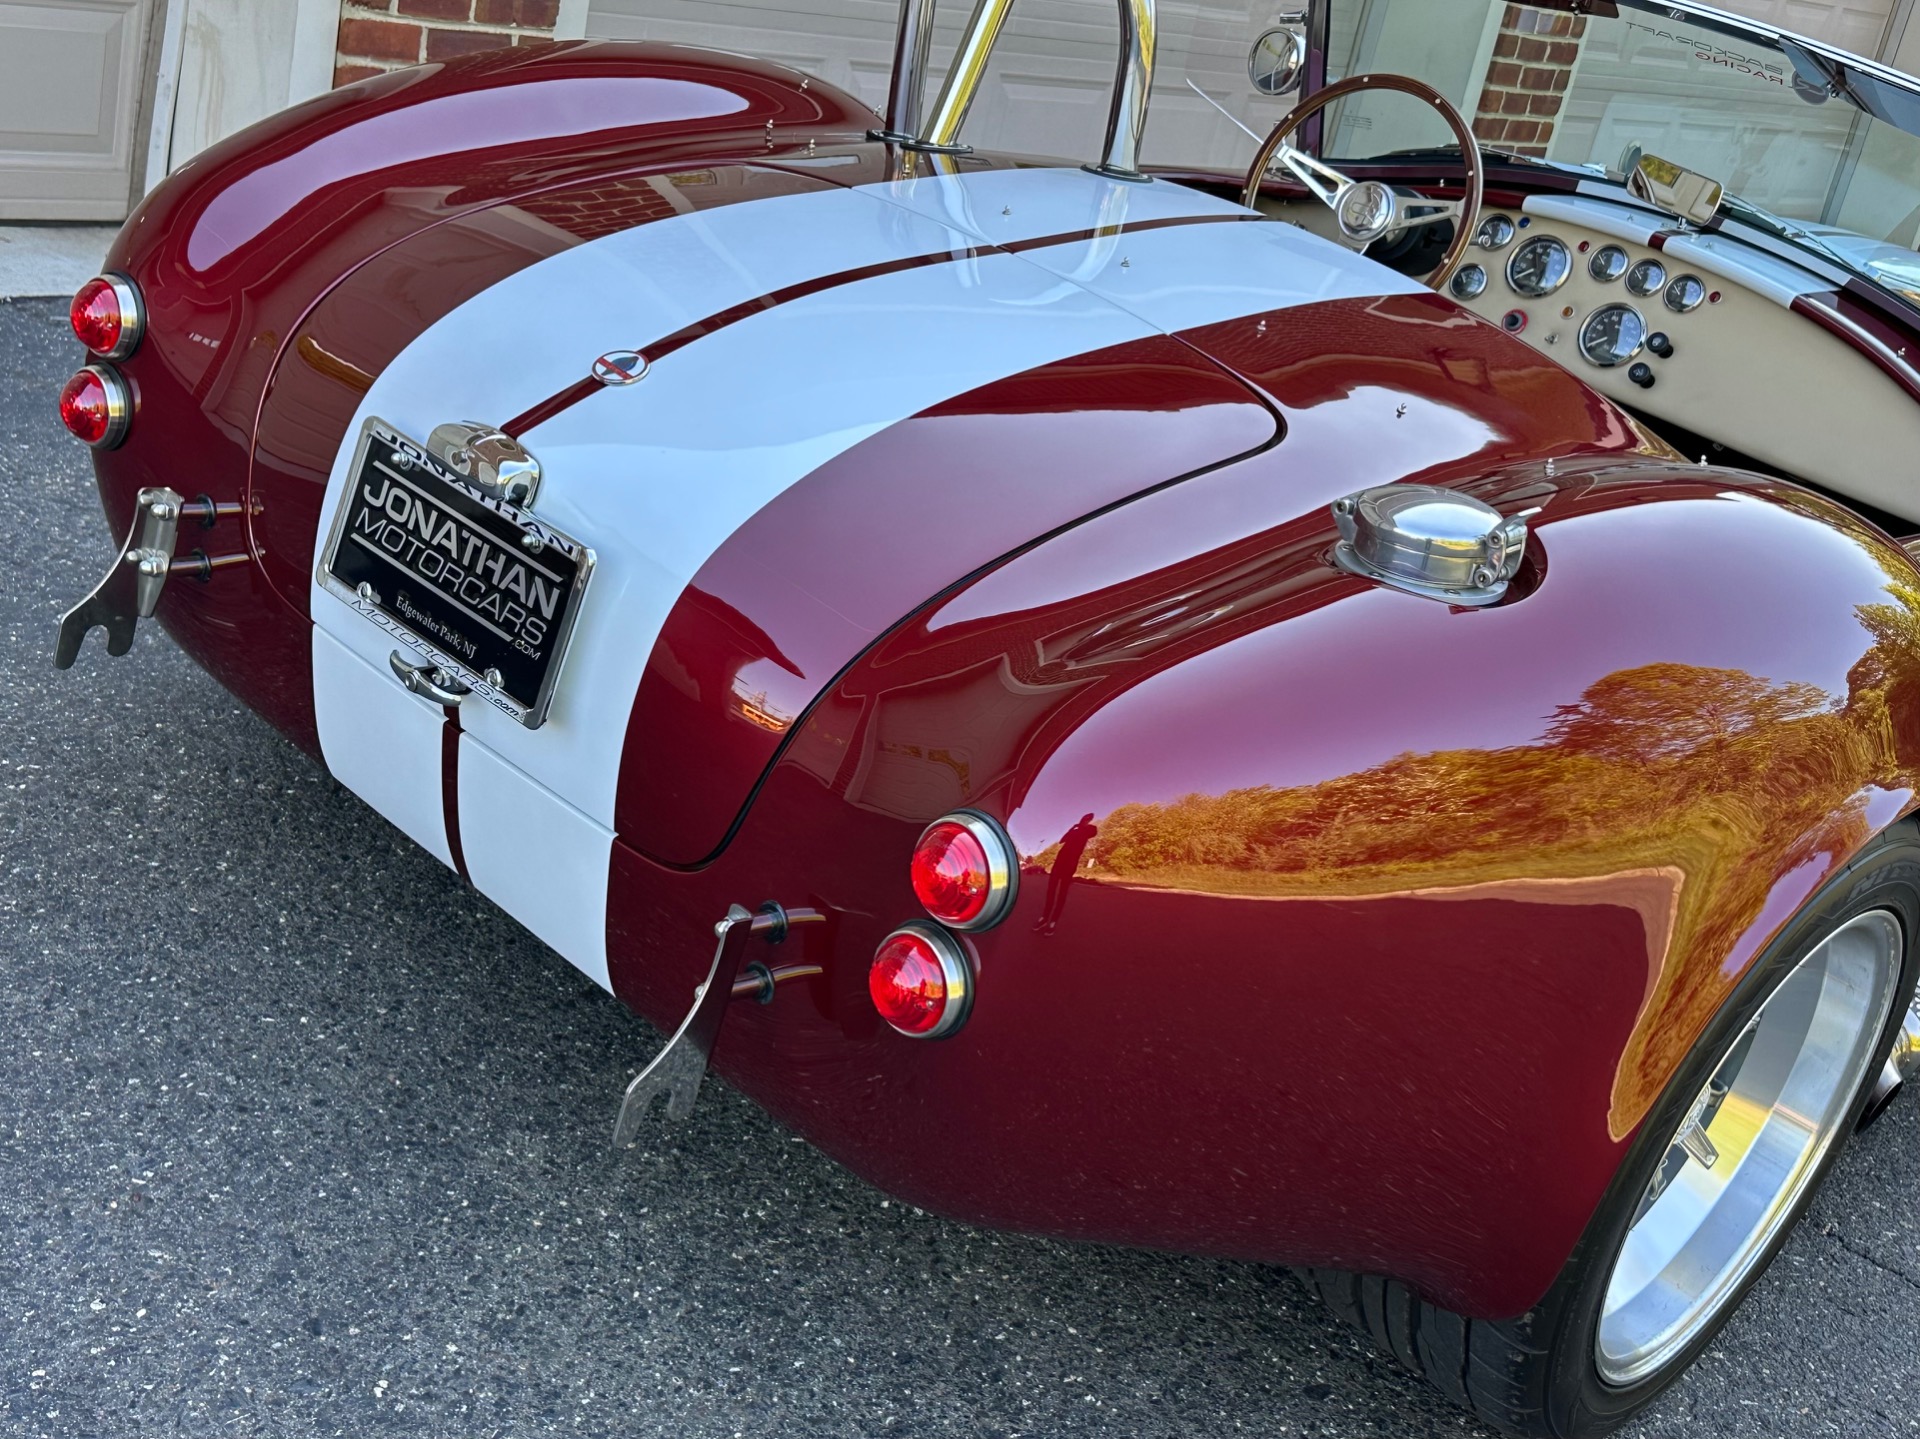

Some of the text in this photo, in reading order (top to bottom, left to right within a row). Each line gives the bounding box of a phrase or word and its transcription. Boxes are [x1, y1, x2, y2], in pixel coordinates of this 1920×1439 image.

[355, 507, 547, 646] MOTORCARS
[363, 479, 561, 621] JONATHAN
[396, 595, 477, 659] Edgewater Park, NJ
